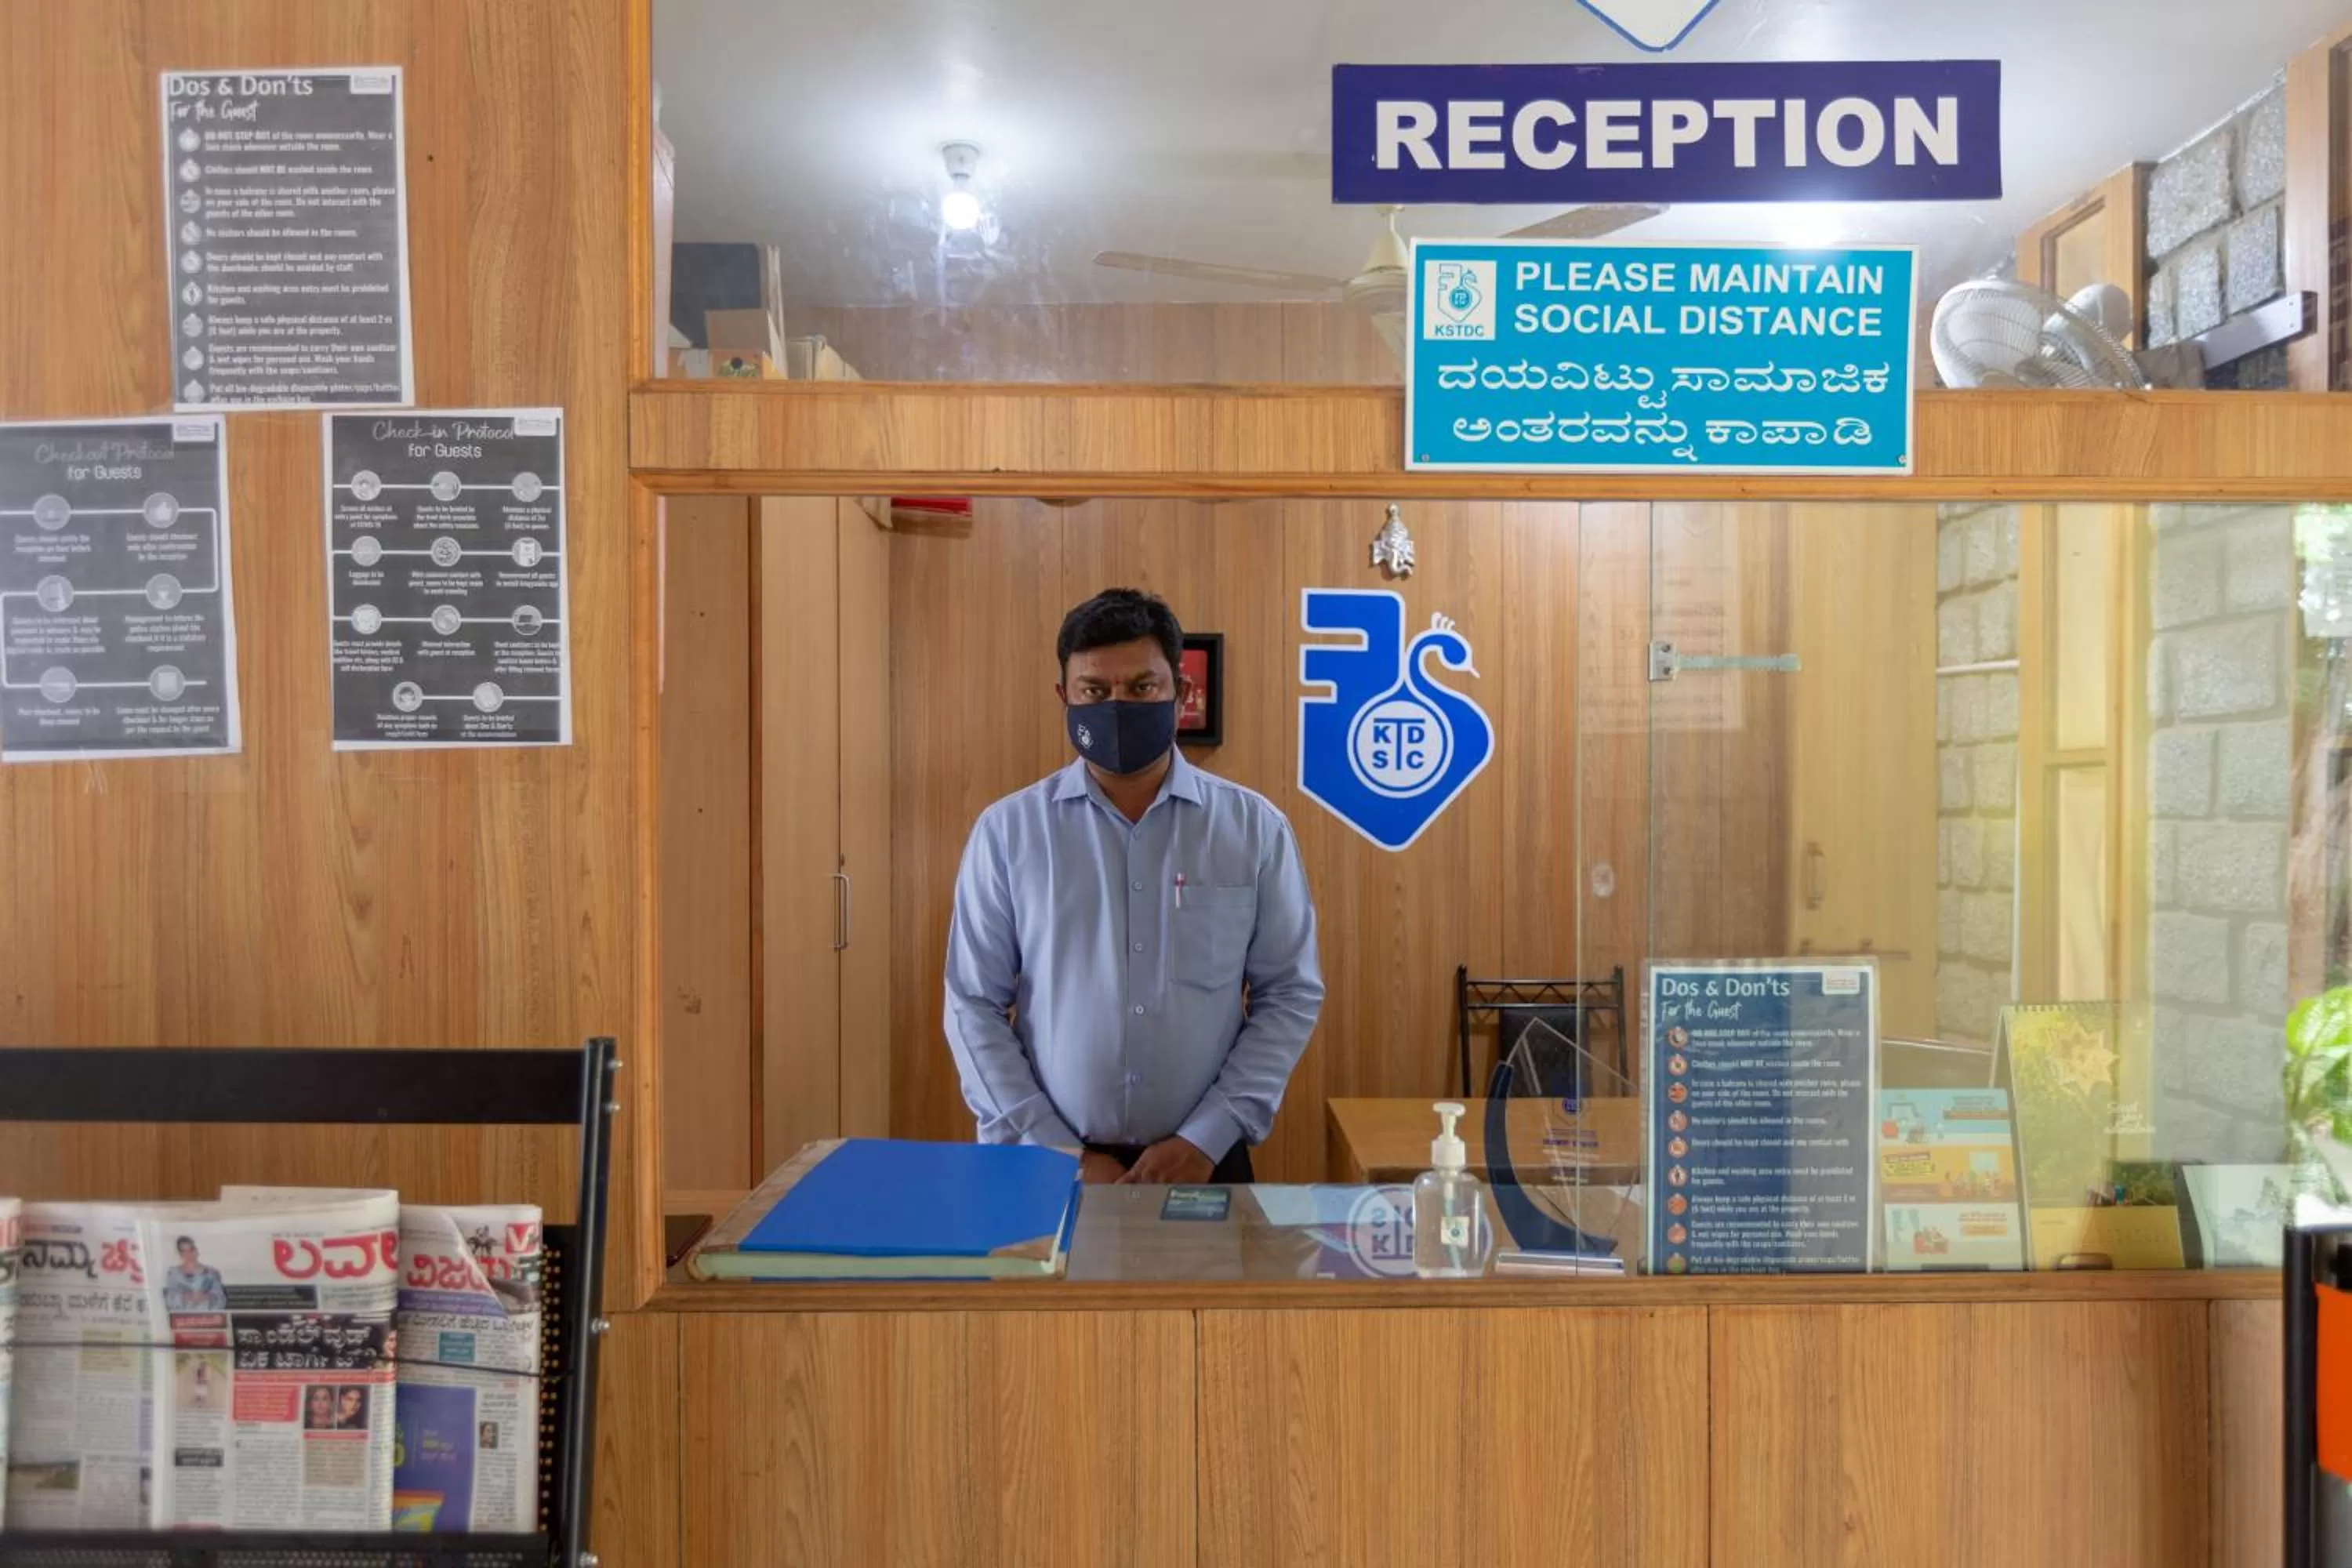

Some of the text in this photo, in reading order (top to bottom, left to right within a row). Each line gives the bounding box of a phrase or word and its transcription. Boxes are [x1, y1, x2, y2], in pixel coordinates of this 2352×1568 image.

[169, 76, 210, 96] Dos
[218, 78, 233, 96] &
[220, 99, 260, 122] Guest
[1376, 96, 1958, 170] RECEPTION
[1517, 262, 1883, 295] PLEASE MAINTAIN
[1434, 323, 1486, 337] KSTDC
[1515, 303, 1882, 337] SOCIAL DISTANCE
[1438, 357, 1890, 409] ದಯವಿಟ್ಟು ಸಾಮಾಜಿಕ
[1453, 411, 1872, 461] ಅಂತರವನ್ನು ಕಾಪಾಡಿ
[407, 442, 482, 459] for Guests
[67, 465, 143, 481] for Guests
[1661, 978, 1699, 996] Dos
[1705, 979, 1719, 996] &
[1685, 998, 1702, 1021] the
[1707, 1000, 1742, 1021] Guest
[23, 1238, 97, 1279] ನಮ್ಮ
